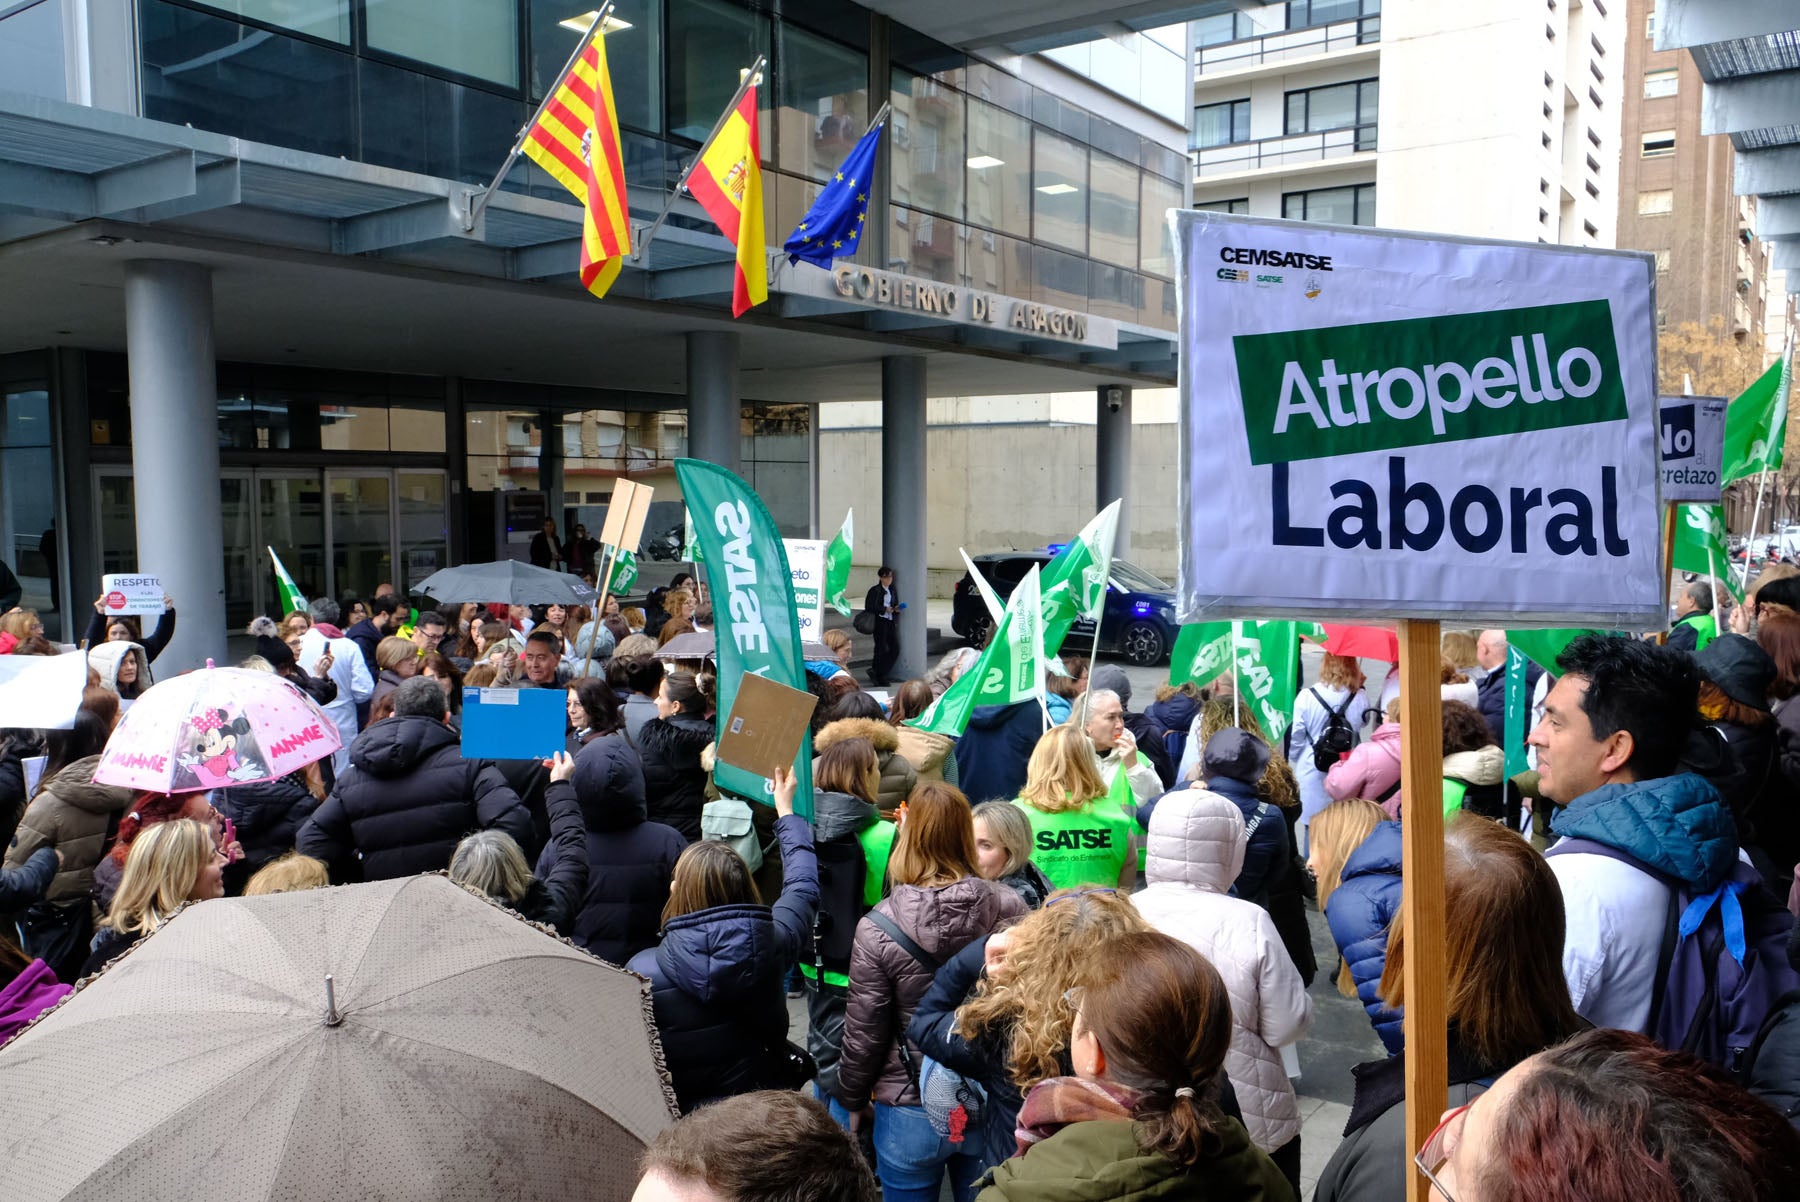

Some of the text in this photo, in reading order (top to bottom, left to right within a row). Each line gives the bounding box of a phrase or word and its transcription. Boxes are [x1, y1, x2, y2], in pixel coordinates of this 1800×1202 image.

[1220, 247, 1333, 271] CEMSATSE
[1256, 274, 1283, 283] SATSE
[832, 266, 958, 314] GOBIERNO
[971, 293, 997, 323] DE
[1273, 333, 1602, 435] Atropello
[1660, 423, 1692, 455] No
[1272, 456, 1630, 557] Laboral
[269, 724, 324, 758] MINNIE
[110, 752, 168, 774] MINNIE
[1036, 828, 1112, 851] SATSE
[1036, 855, 1069, 863] Sindicato
